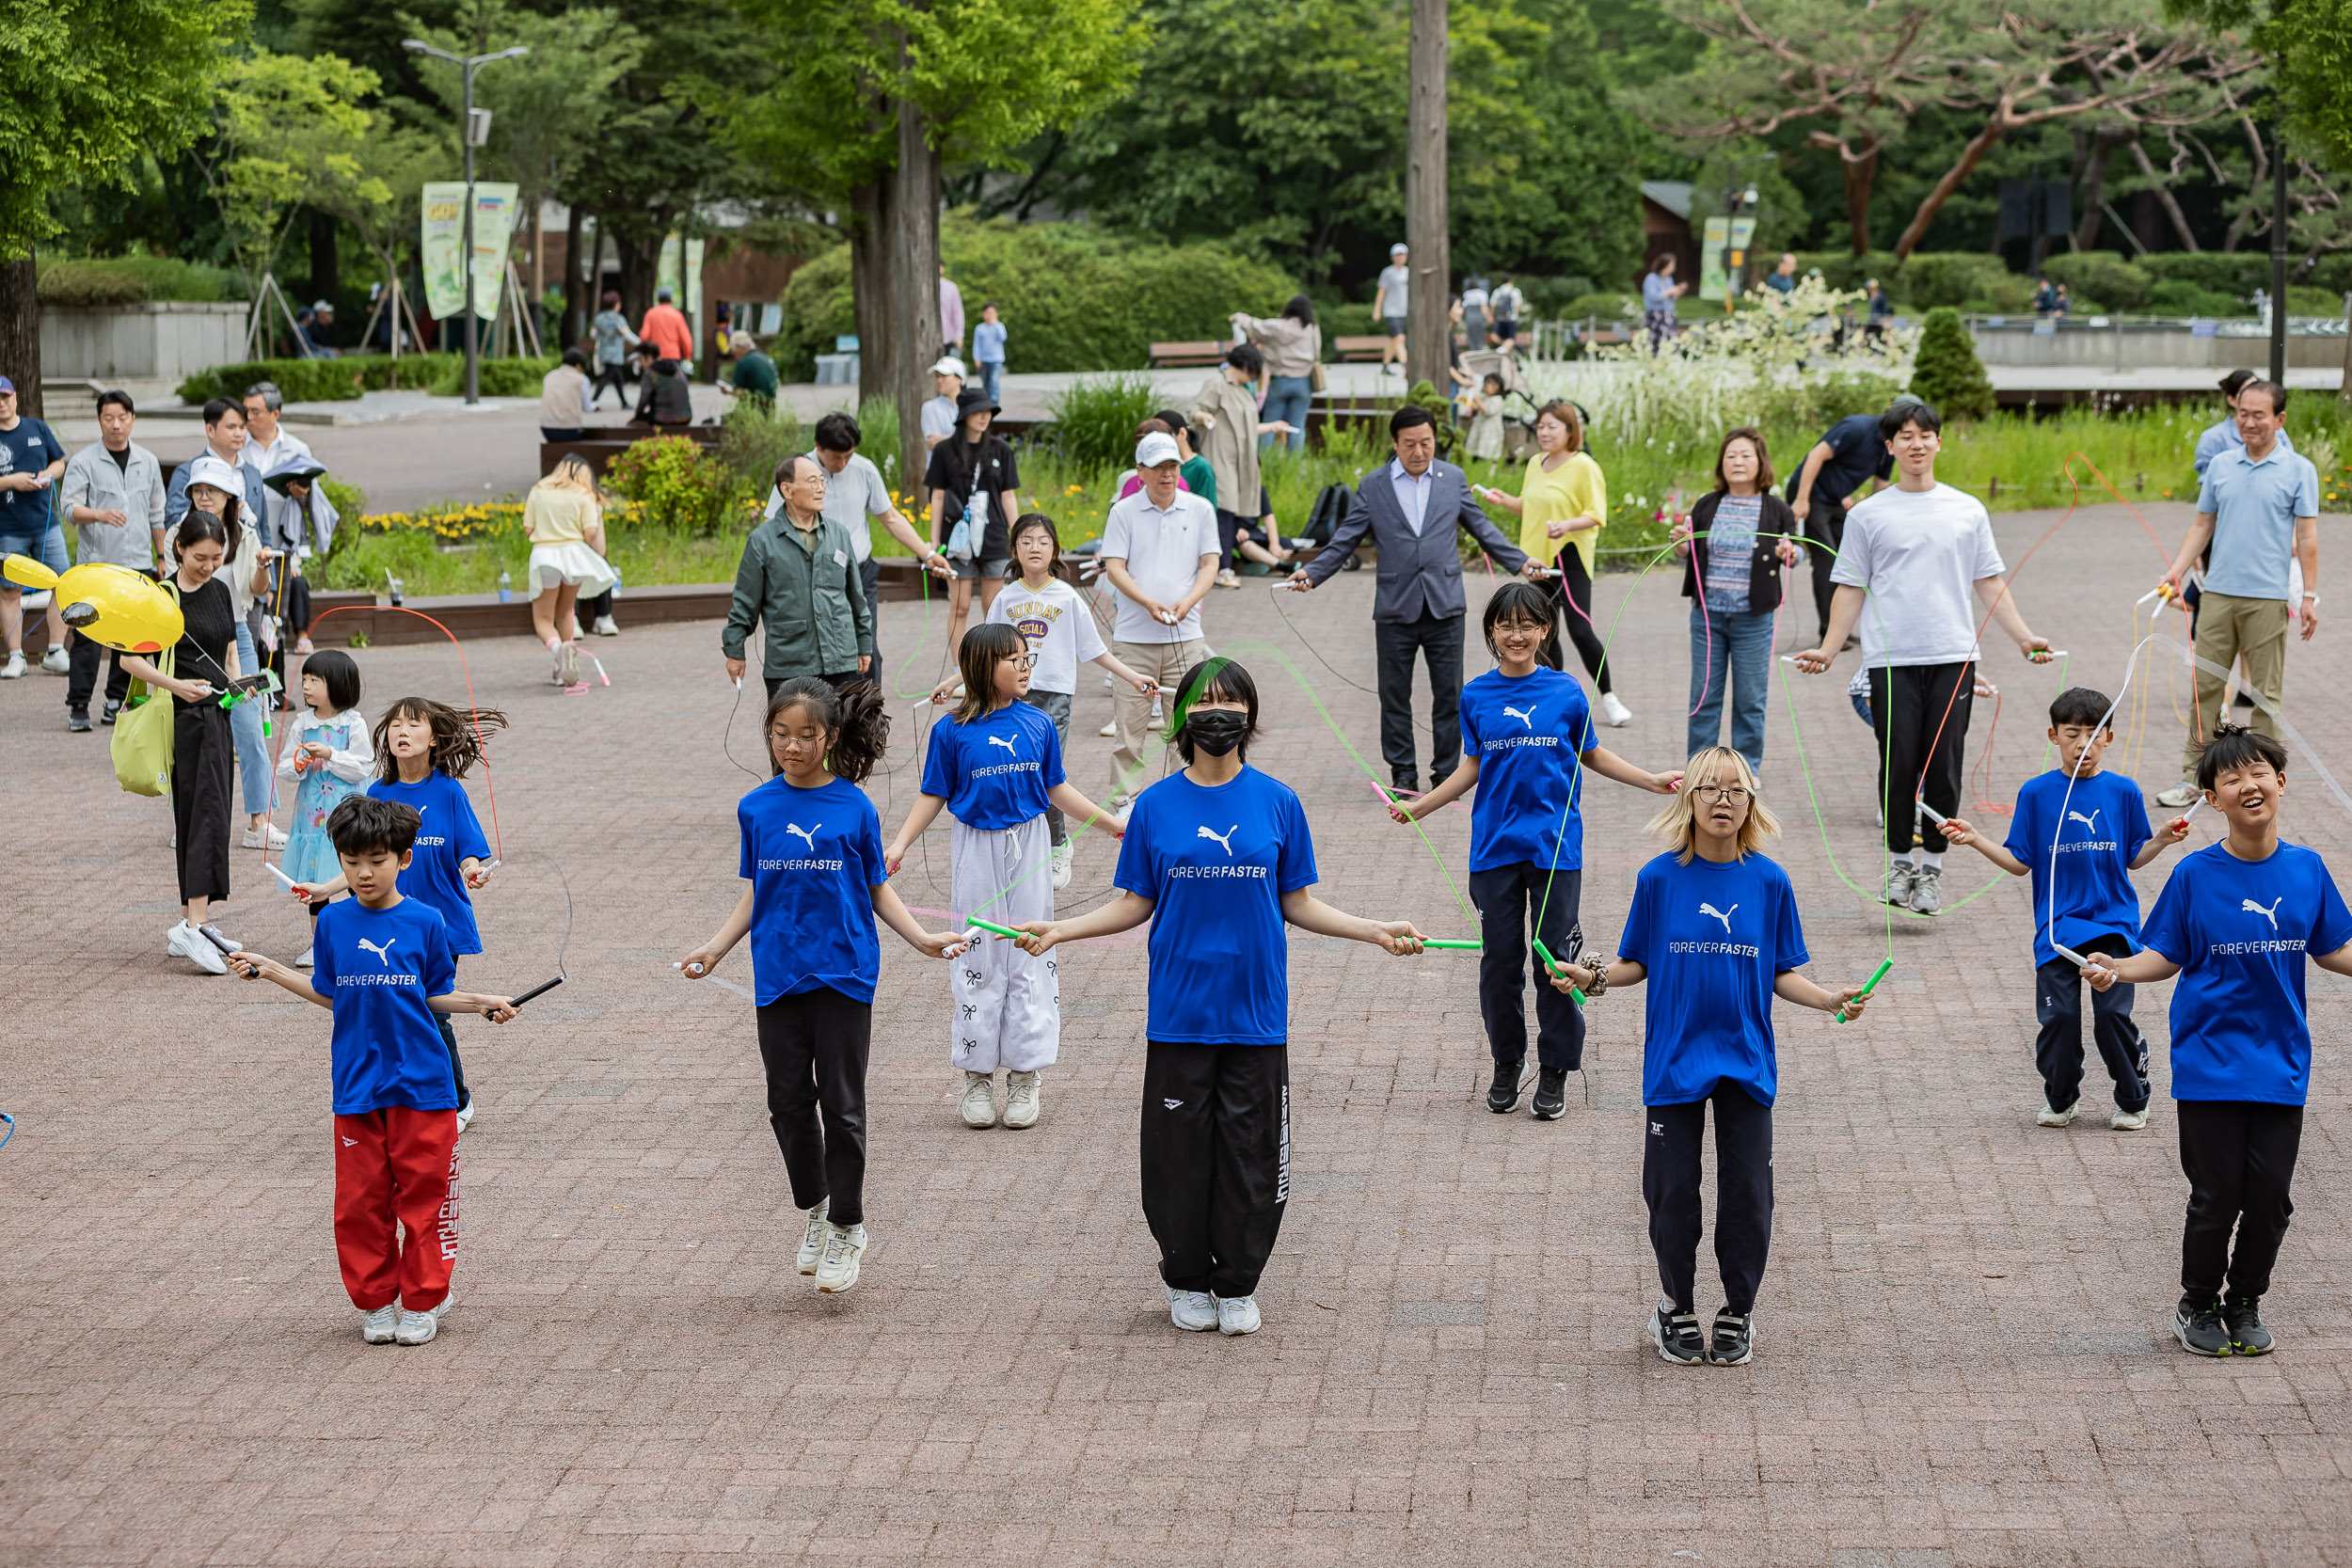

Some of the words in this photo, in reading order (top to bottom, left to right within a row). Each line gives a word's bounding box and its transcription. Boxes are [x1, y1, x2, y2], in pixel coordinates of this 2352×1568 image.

[1007, 601, 1063, 623] SUNDAY
[1019, 624, 1044, 636] SOCIAL
[1483, 736, 1558, 751] FOREVERFASTER
[971, 762, 1041, 779] FOREVERFASTER
[758, 860, 843, 871] FOREVERFASTER
[1168, 865, 1267, 879] FOREVERFASTER
[1669, 942, 1759, 958] FOREVERFASTER
[2211, 940, 2306, 955] FOREVERFASTER
[336, 974, 417, 987] OREVERFASTER
